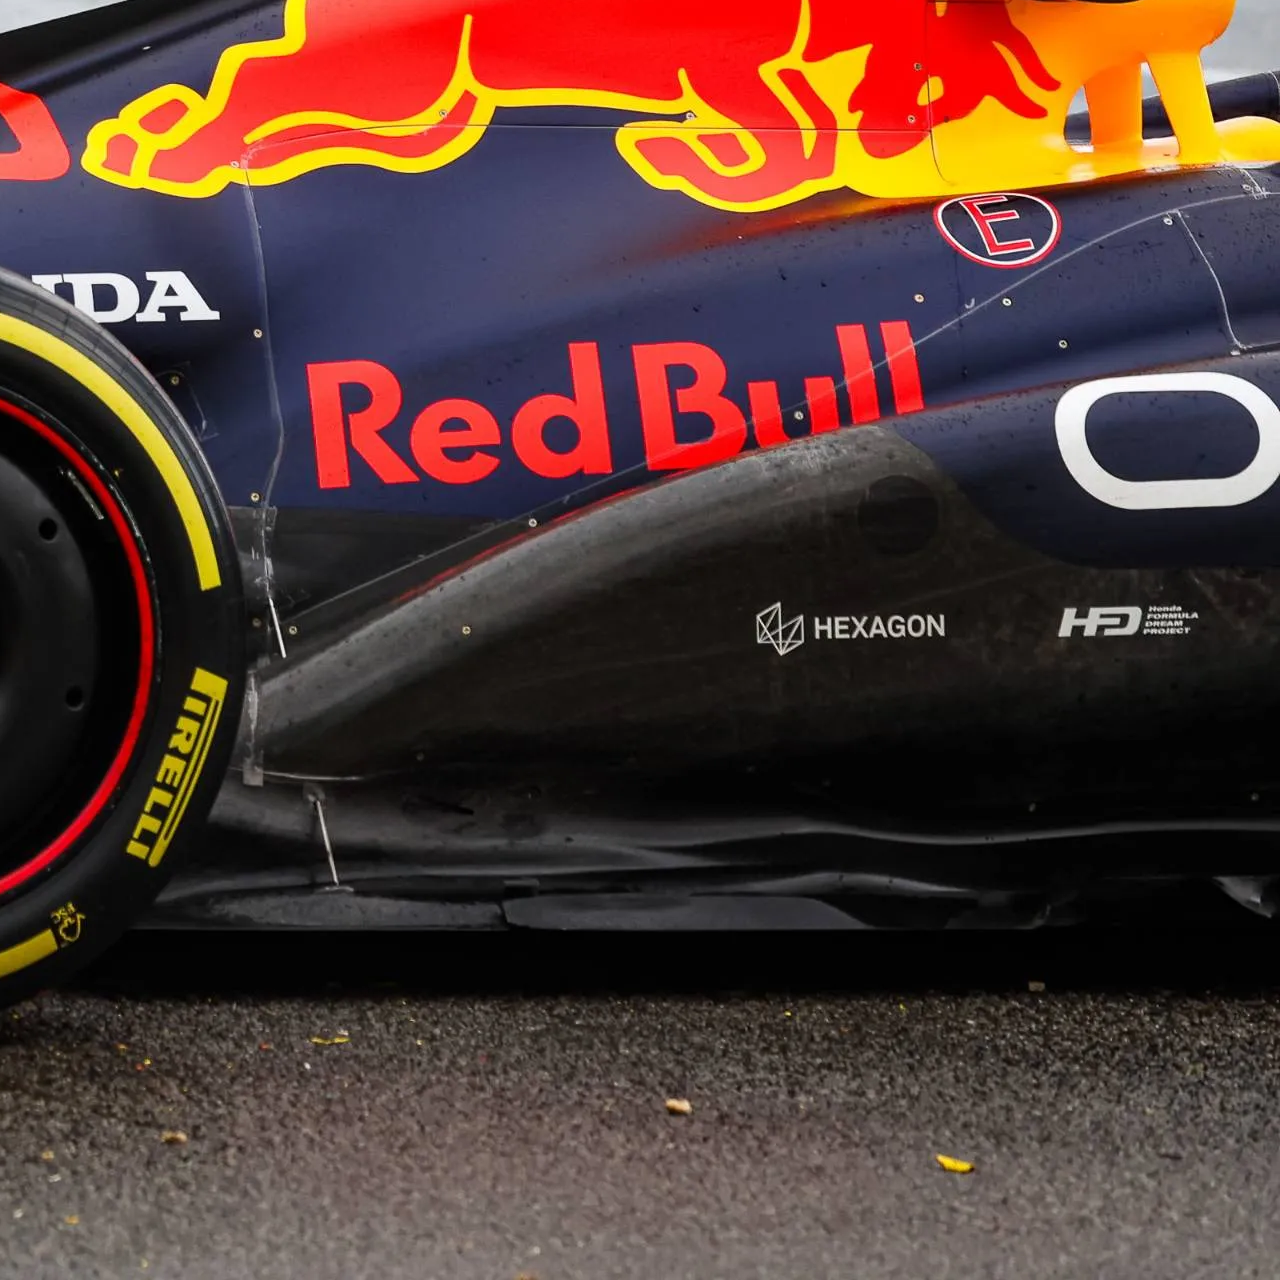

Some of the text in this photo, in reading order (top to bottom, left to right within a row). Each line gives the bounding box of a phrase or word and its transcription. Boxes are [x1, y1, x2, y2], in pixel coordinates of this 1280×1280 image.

[306, 320, 926, 490] Red Bull
[1148, 604, 1183, 613] Honda
[1146, 612, 1200, 620] FORMULA
[814, 614, 946, 641] HEXAGON
[1144, 620, 1184, 628] DREAM
[1142, 627, 1191, 636] PROJECT
[126, 667, 229, 868] PIRELLI
